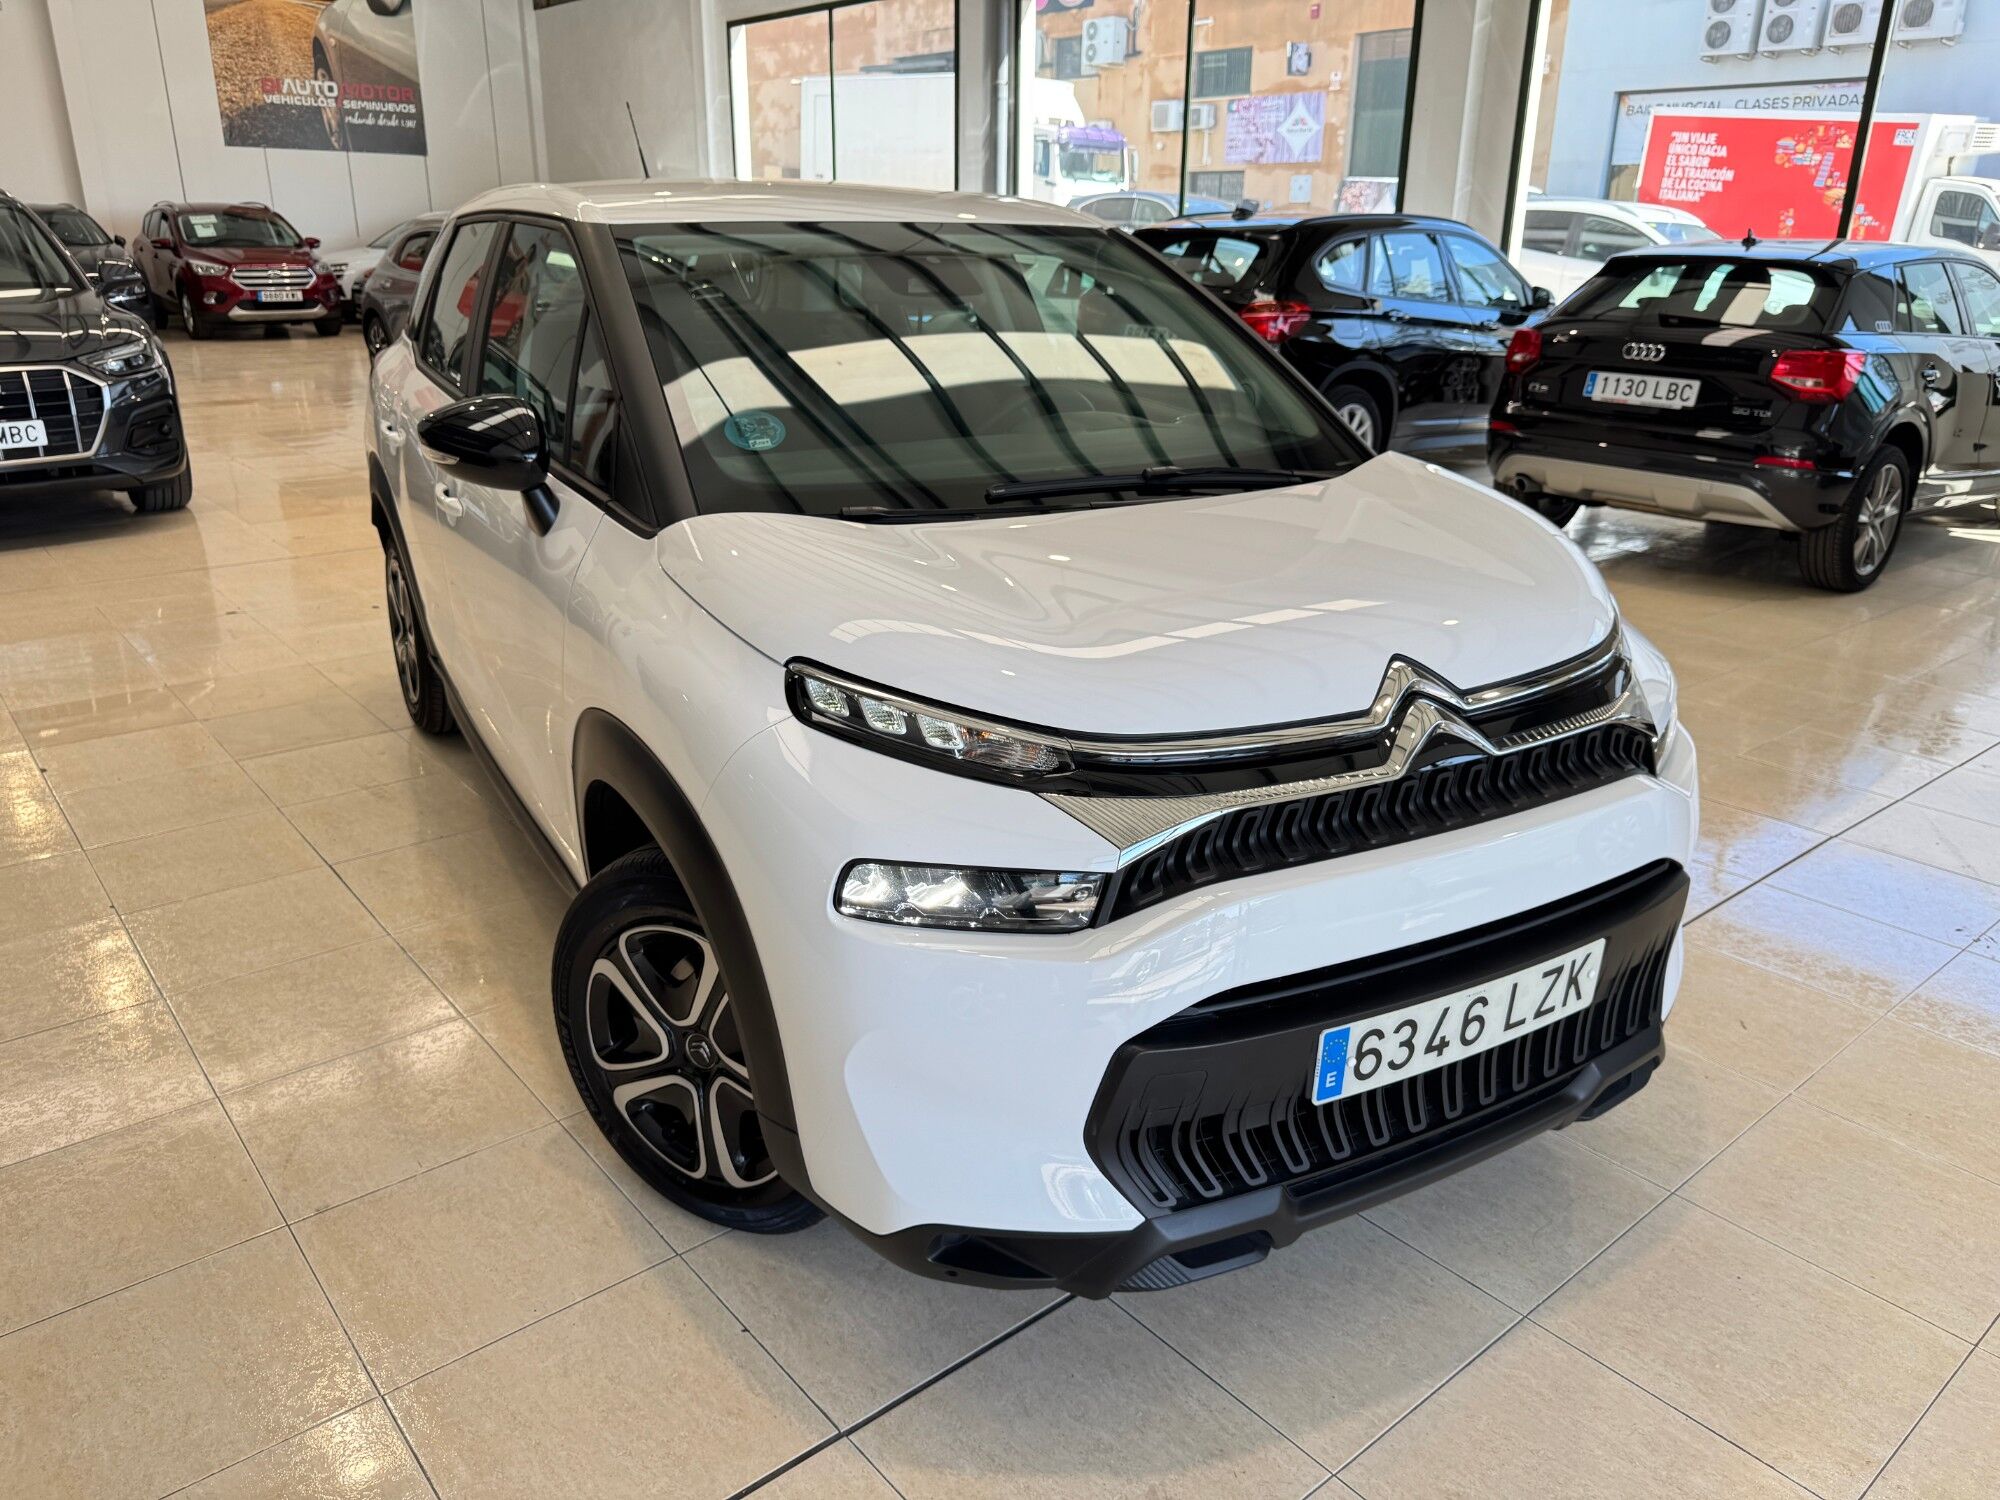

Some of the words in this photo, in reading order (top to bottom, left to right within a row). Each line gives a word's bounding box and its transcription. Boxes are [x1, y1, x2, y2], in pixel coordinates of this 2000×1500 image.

[343, 99, 417, 113] SEMINUEVOS
[1735, 97, 1789, 110] CLASES
[1792, 94, 1864, 108] PRIVADA
[1690, 132, 1718, 144] VIAJE
[1698, 145, 1727, 157] HACIA
[1665, 154, 1678, 166] EL
[1678, 155, 1711, 167] SABOR
[1670, 166, 1683, 178] LA
[1684, 166, 1735, 181] TRADICIÓN
[1660, 177, 1674, 190] DE
[1674, 178, 1687, 190] LA
[1687, 179, 1723, 192] COCINA
[1601, 376, 1648, 397] 1130
[1652, 380, 1693, 402] LBC
[1325, 1071, 1337, 1088] E
[1353, 996, 1489, 1081] 6346
[1503, 952, 1592, 1032] LZK
